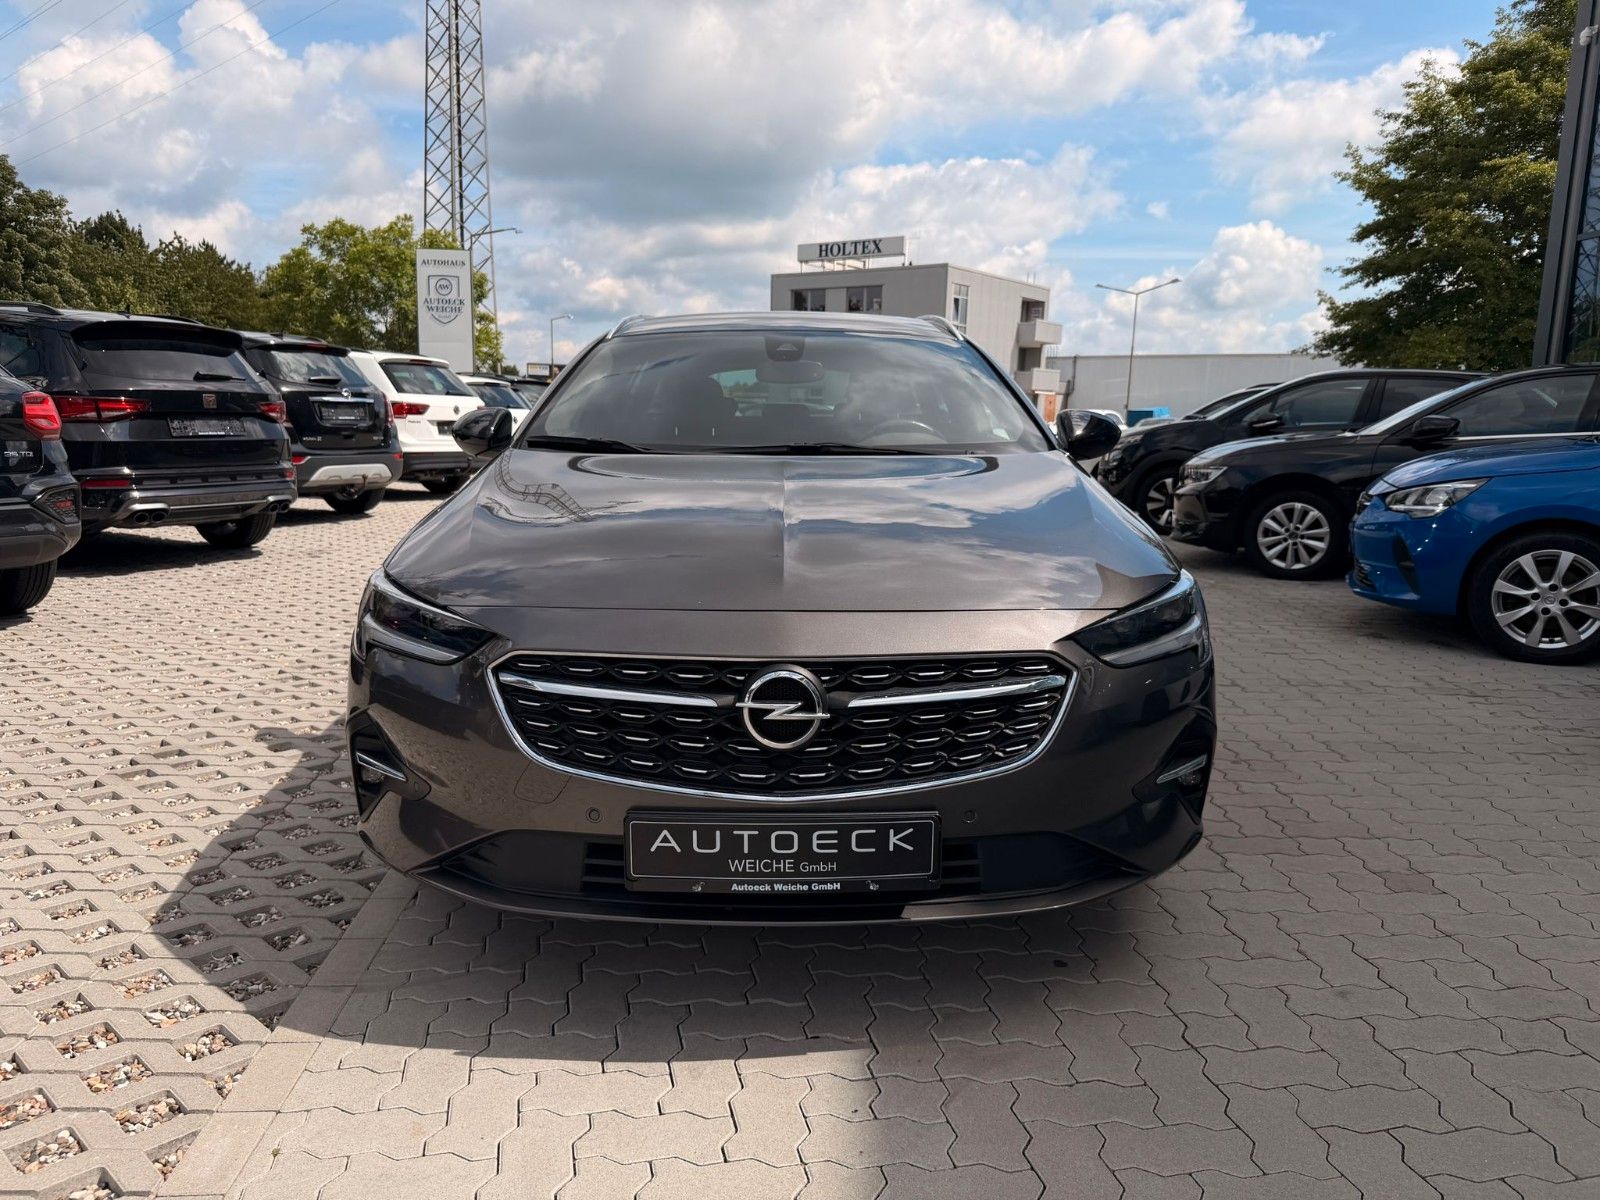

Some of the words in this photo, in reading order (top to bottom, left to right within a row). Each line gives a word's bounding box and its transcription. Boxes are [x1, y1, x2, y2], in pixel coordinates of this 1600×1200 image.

[818, 239, 882, 258] HOLTEX
[421, 259, 466, 267] AUTOHAUS
[423, 298, 465, 306] AUTOECK
[426, 305, 463, 313] WEICHE
[650, 828, 914, 853] AUTOECK
[728, 859, 795, 873] WEICHE
[799, 861, 837, 872] GmbH
[731, 883, 772, 892] Autoeck
[773, 883, 809, 892] Weiche
[811, 882, 841, 891] GmbH
